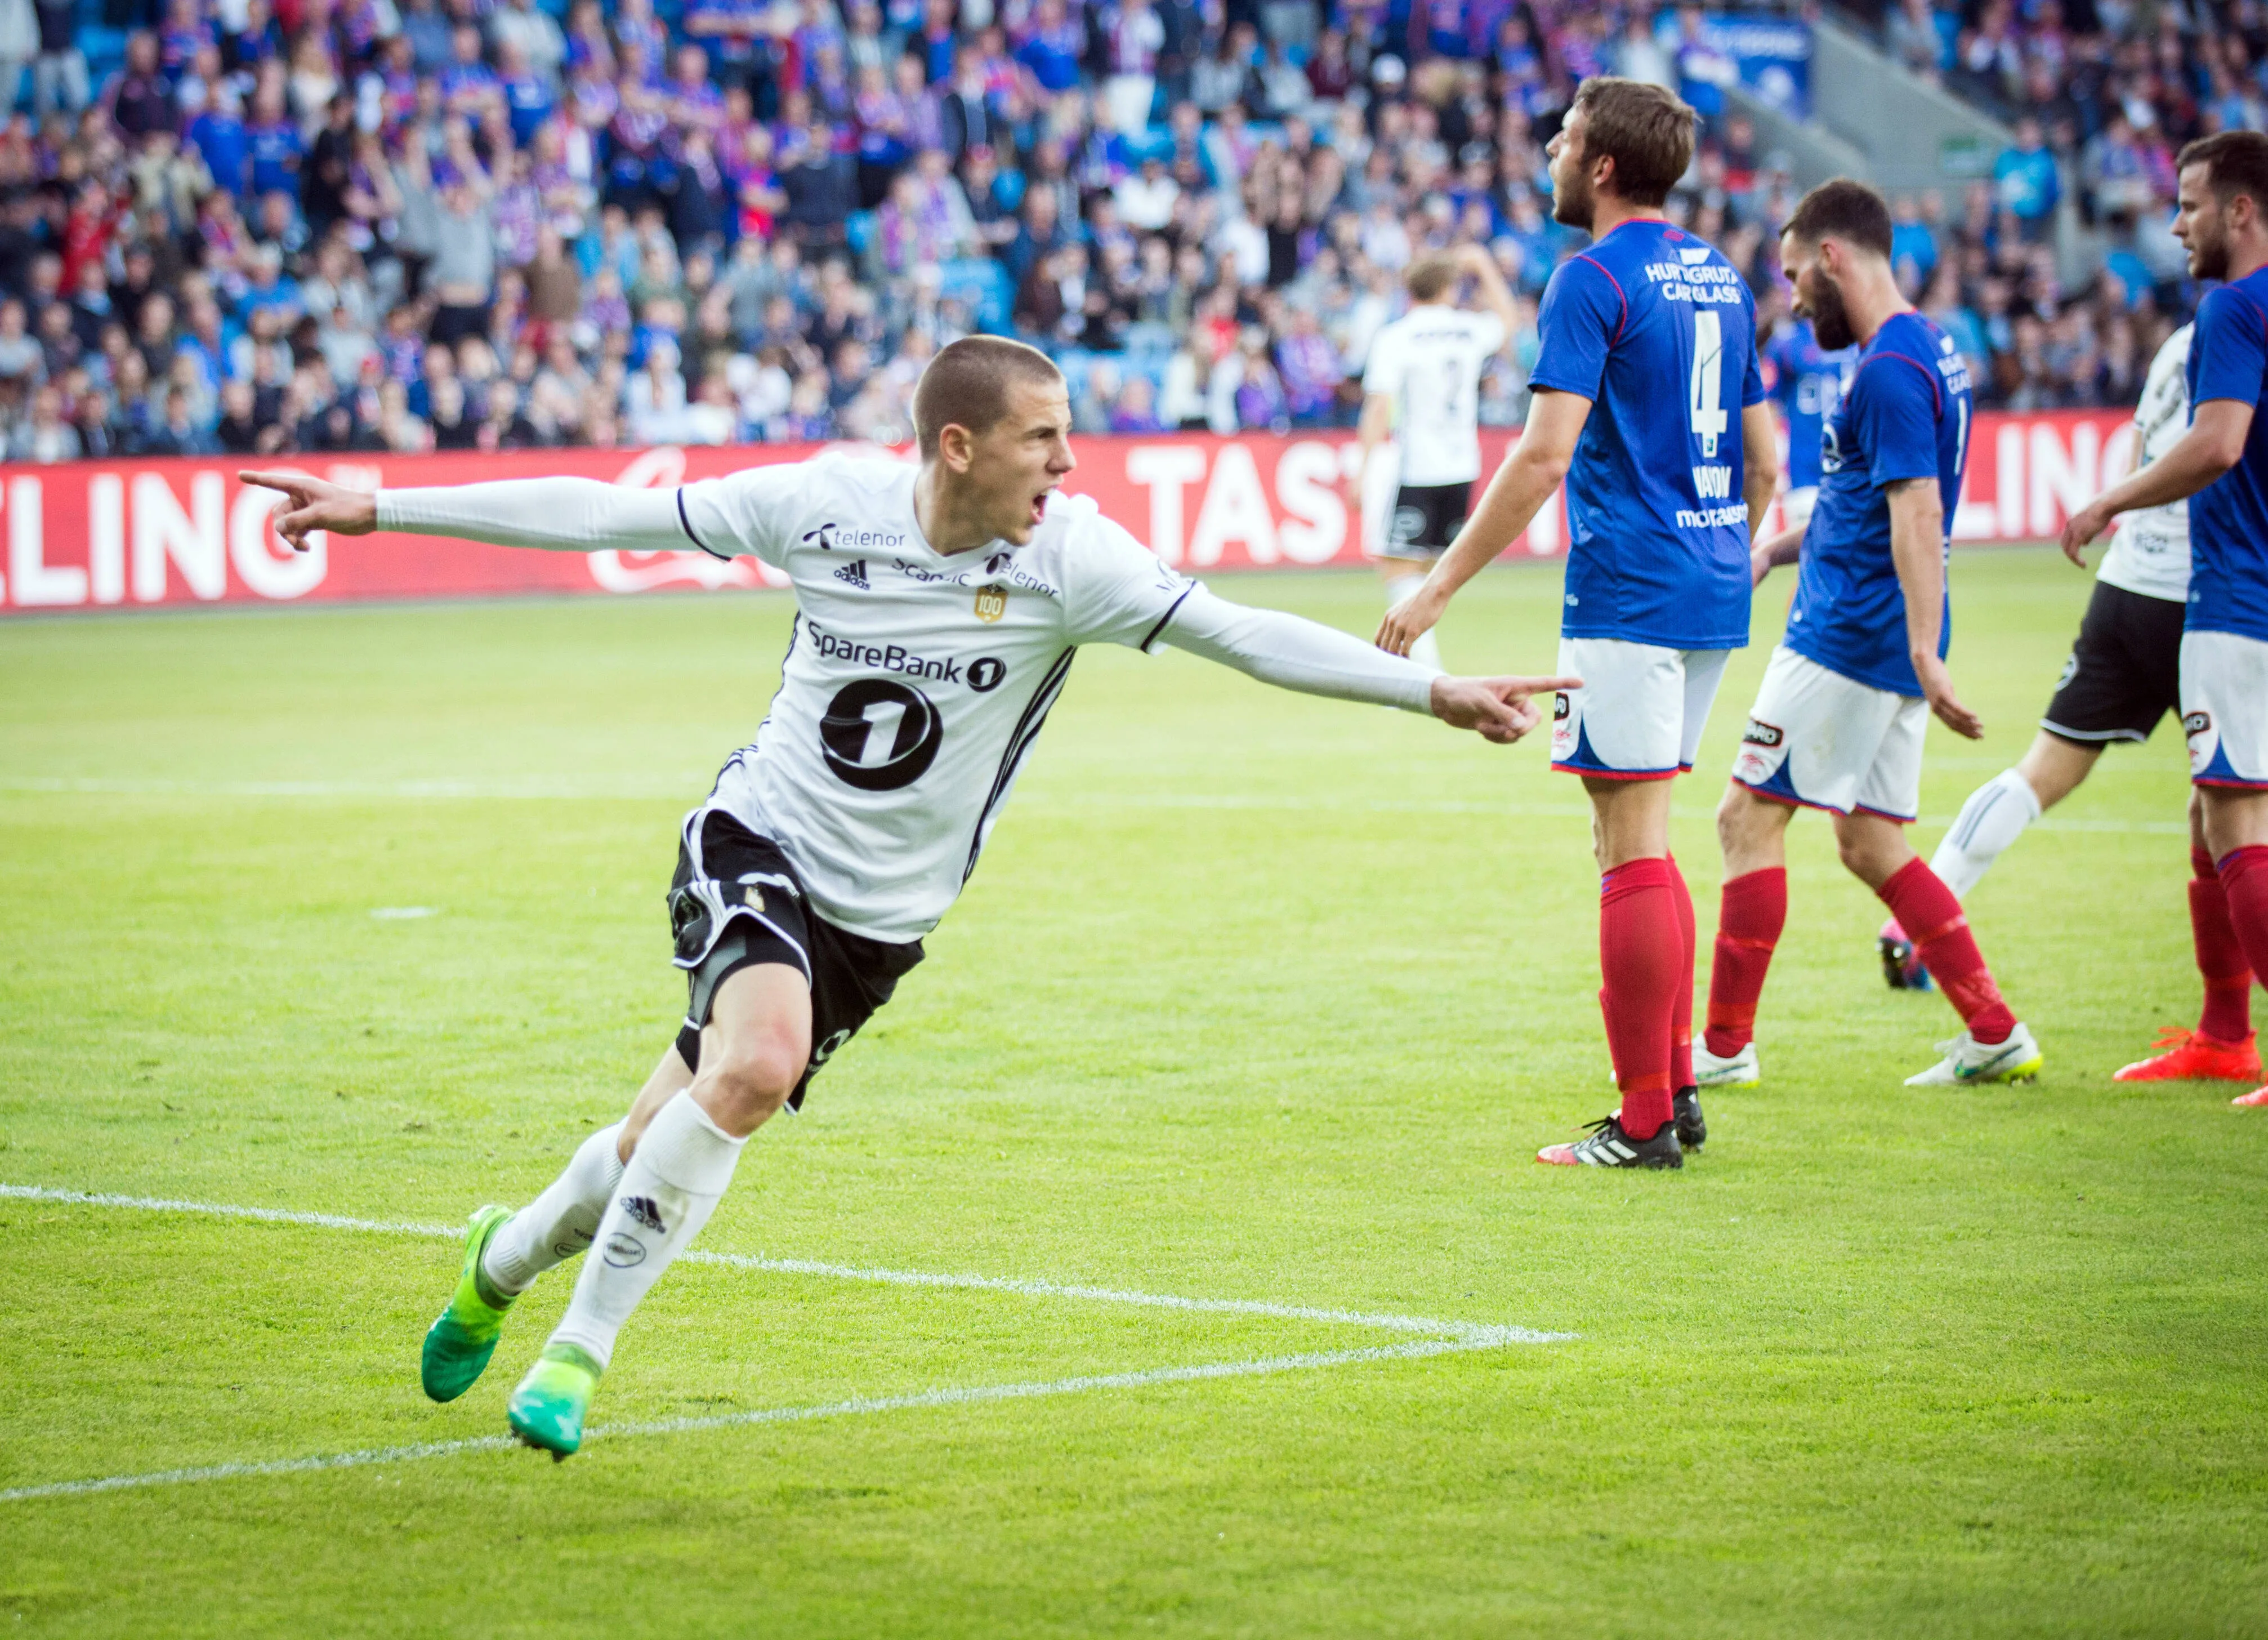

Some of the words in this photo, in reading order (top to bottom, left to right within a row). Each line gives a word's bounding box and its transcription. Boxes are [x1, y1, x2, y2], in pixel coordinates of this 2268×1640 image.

[1690, 310, 1727, 458] 4
[0, 466, 328, 607] LING
[834, 529, 905, 547] telenor
[834, 569, 871, 591] adidas
[999, 561, 1059, 598] elenor
[978, 594, 1002, 616] 100
[808, 620, 963, 684] SpareBank
